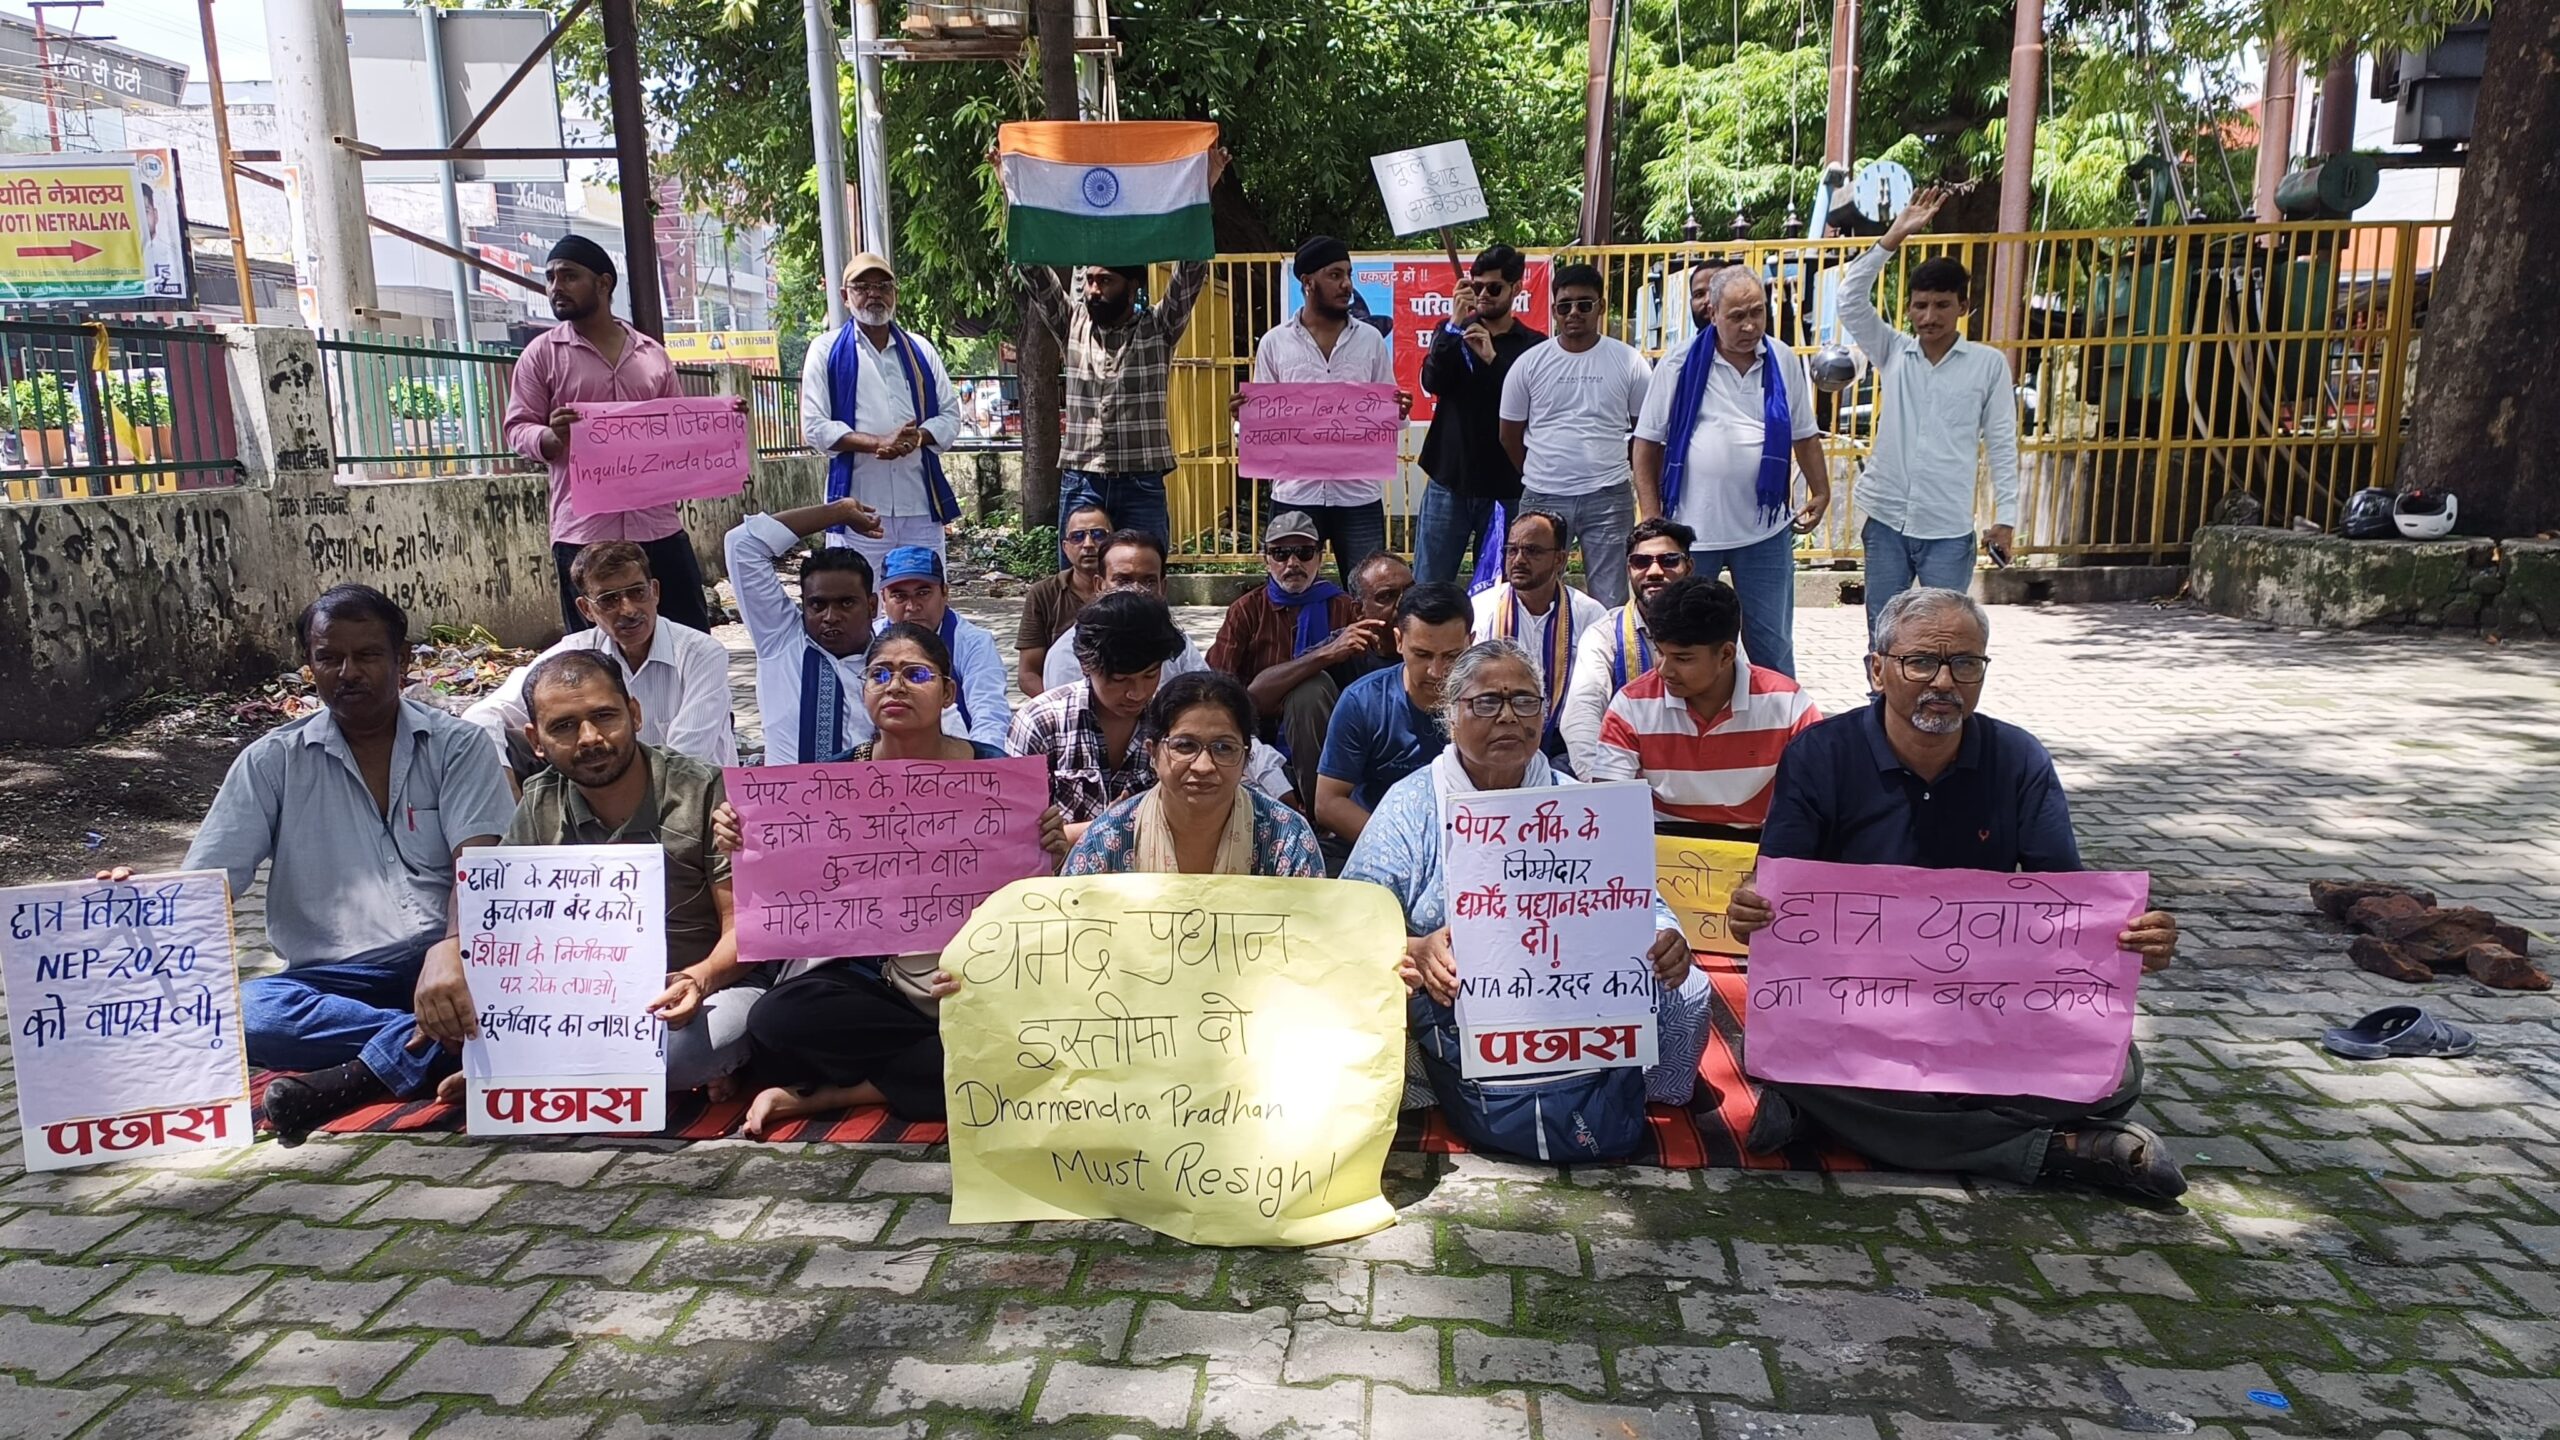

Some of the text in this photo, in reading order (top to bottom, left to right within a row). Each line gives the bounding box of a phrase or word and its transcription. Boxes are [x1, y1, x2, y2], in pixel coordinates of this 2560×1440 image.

[47, 179, 124, 206] नेत्रालय
[36, 211, 131, 232] NETRALAYA
[1358, 269, 1399, 286] एकजुट
[1402, 266, 1416, 282] हों
[1244, 427, 1309, 446] सरकार
[742, 763, 1000, 806] पेपर लीक के खिलाफ
[761, 797, 1012, 849] छात्रों के आंदोलन को
[1454, 800, 1599, 844] पेपर लीक के
[524, 863, 542, 889] के
[547, 864, 605, 890] सपनों
[609, 862, 640, 891] को
[822, 838, 984, 892] कुचलने वाले
[1502, 849, 1593, 885] जिम्मेदार
[10, 882, 184, 940] छात्र विरोधी
[483, 899, 558, 931] कुचलना
[563, 893, 591, 922] बंद
[762, 889, 883, 936] मोदी-शाह
[1516, 890, 1576, 920] प्रधान
[1577, 876, 1653, 917] इस्तीफा
[1772, 891, 1898, 946] छात्र
[471, 932, 633, 967] शिक्षा के निजीकरण
[500, 976, 523, 995] पर
[527, 969, 557, 994] रोक
[1457, 977, 1501, 1002] NTA
[1754, 967, 2120, 1018] का दमन बन्द करो
[23, 994, 67, 1047] को
[85, 995, 164, 1036] वापस
[480, 1004, 553, 1042] पूंजीवाद
[558, 1013, 583, 1038] का
[588, 1013, 629, 1039] नाश
[1017, 990, 1253, 1071] इस्तीफा दो
[1474, 1024, 1643, 1066] पछास
[481, 1087, 649, 1125] पछास
[955, 1080, 1285, 1129] Dharmendra Pradhan
[41, 1104, 232, 1156] पछास
[1051, 1141, 1336, 1218] Must Resign!
